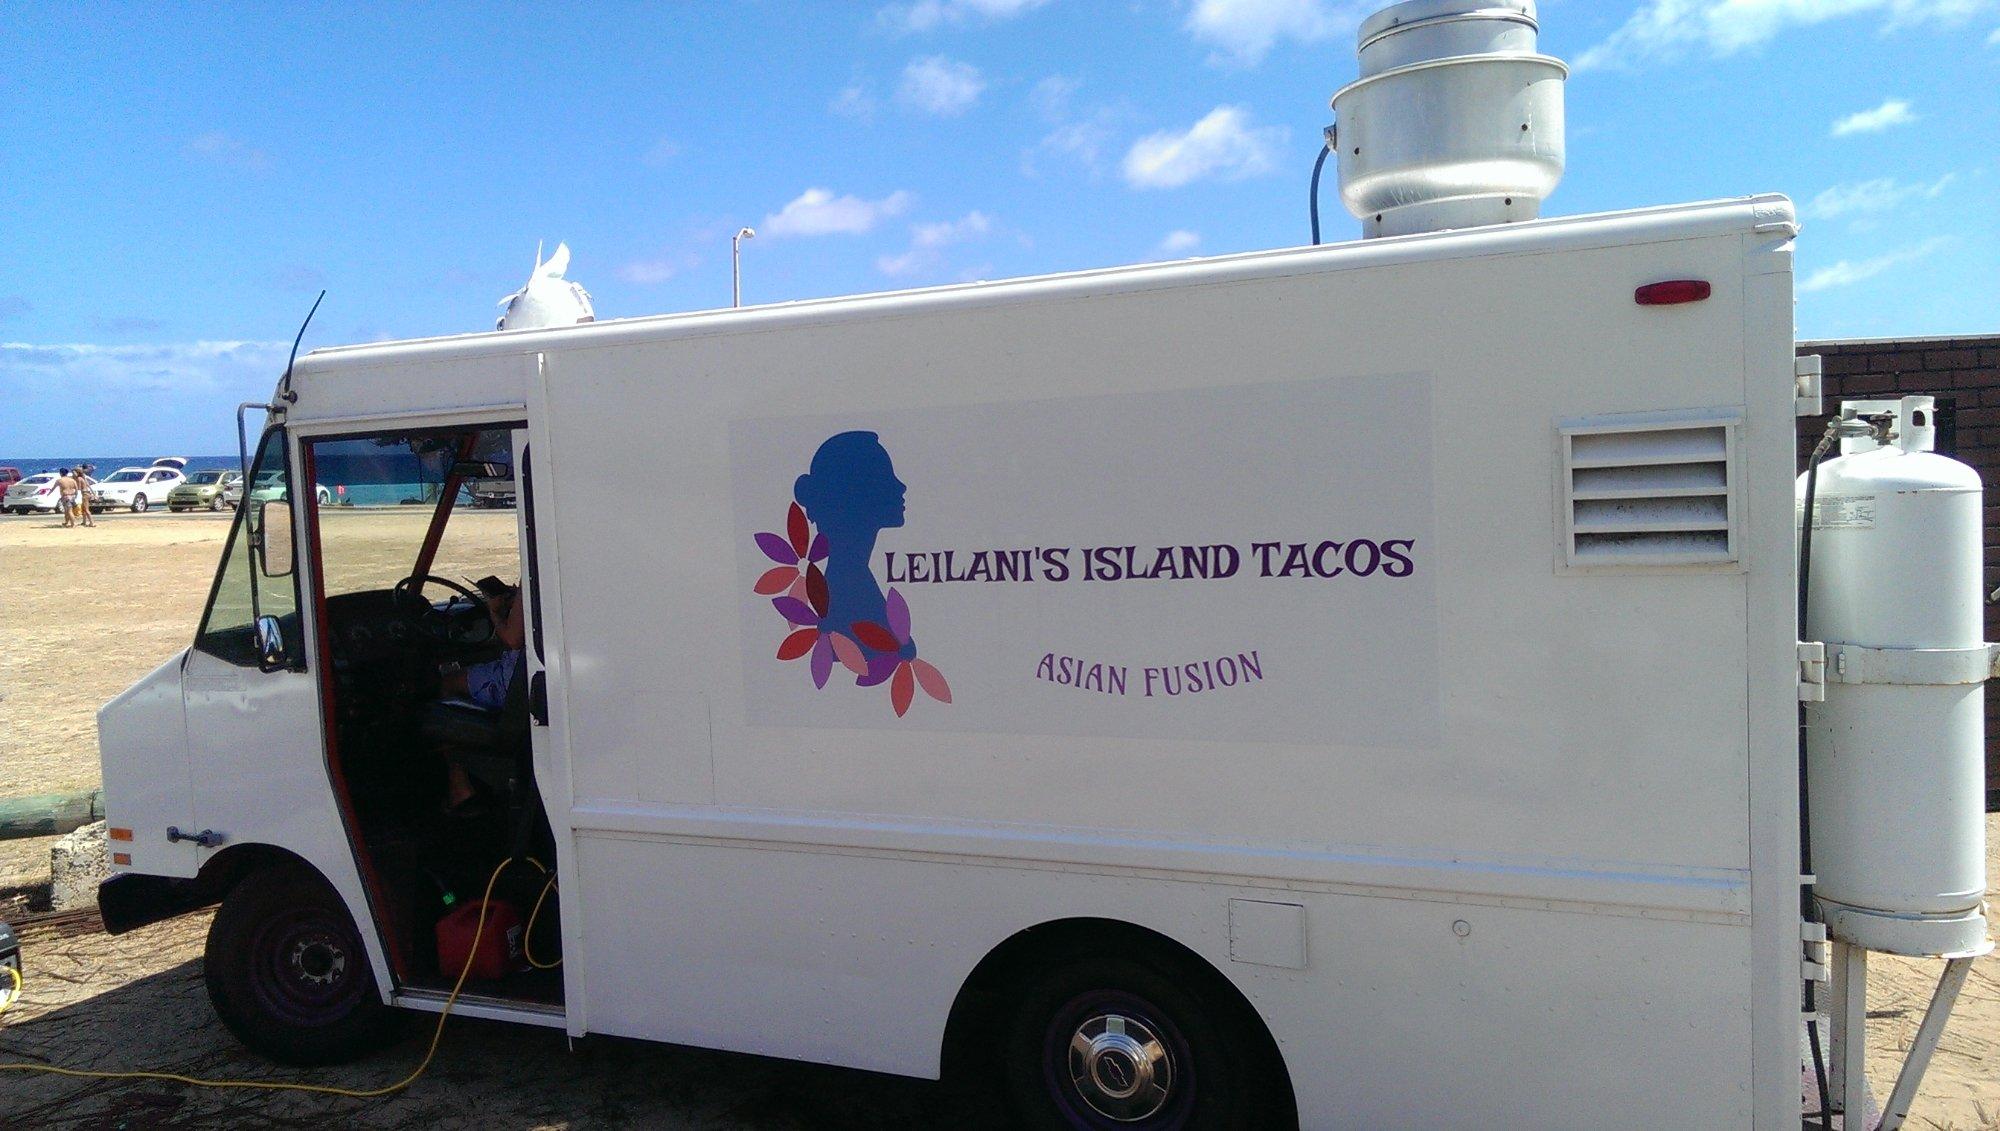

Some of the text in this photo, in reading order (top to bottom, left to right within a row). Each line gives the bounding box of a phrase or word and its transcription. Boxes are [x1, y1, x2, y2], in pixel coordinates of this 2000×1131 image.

[884, 538, 1416, 584] LEILANI'S ISLAND TACOS
[1036, 650, 1264, 697] ASIAN FUSION
